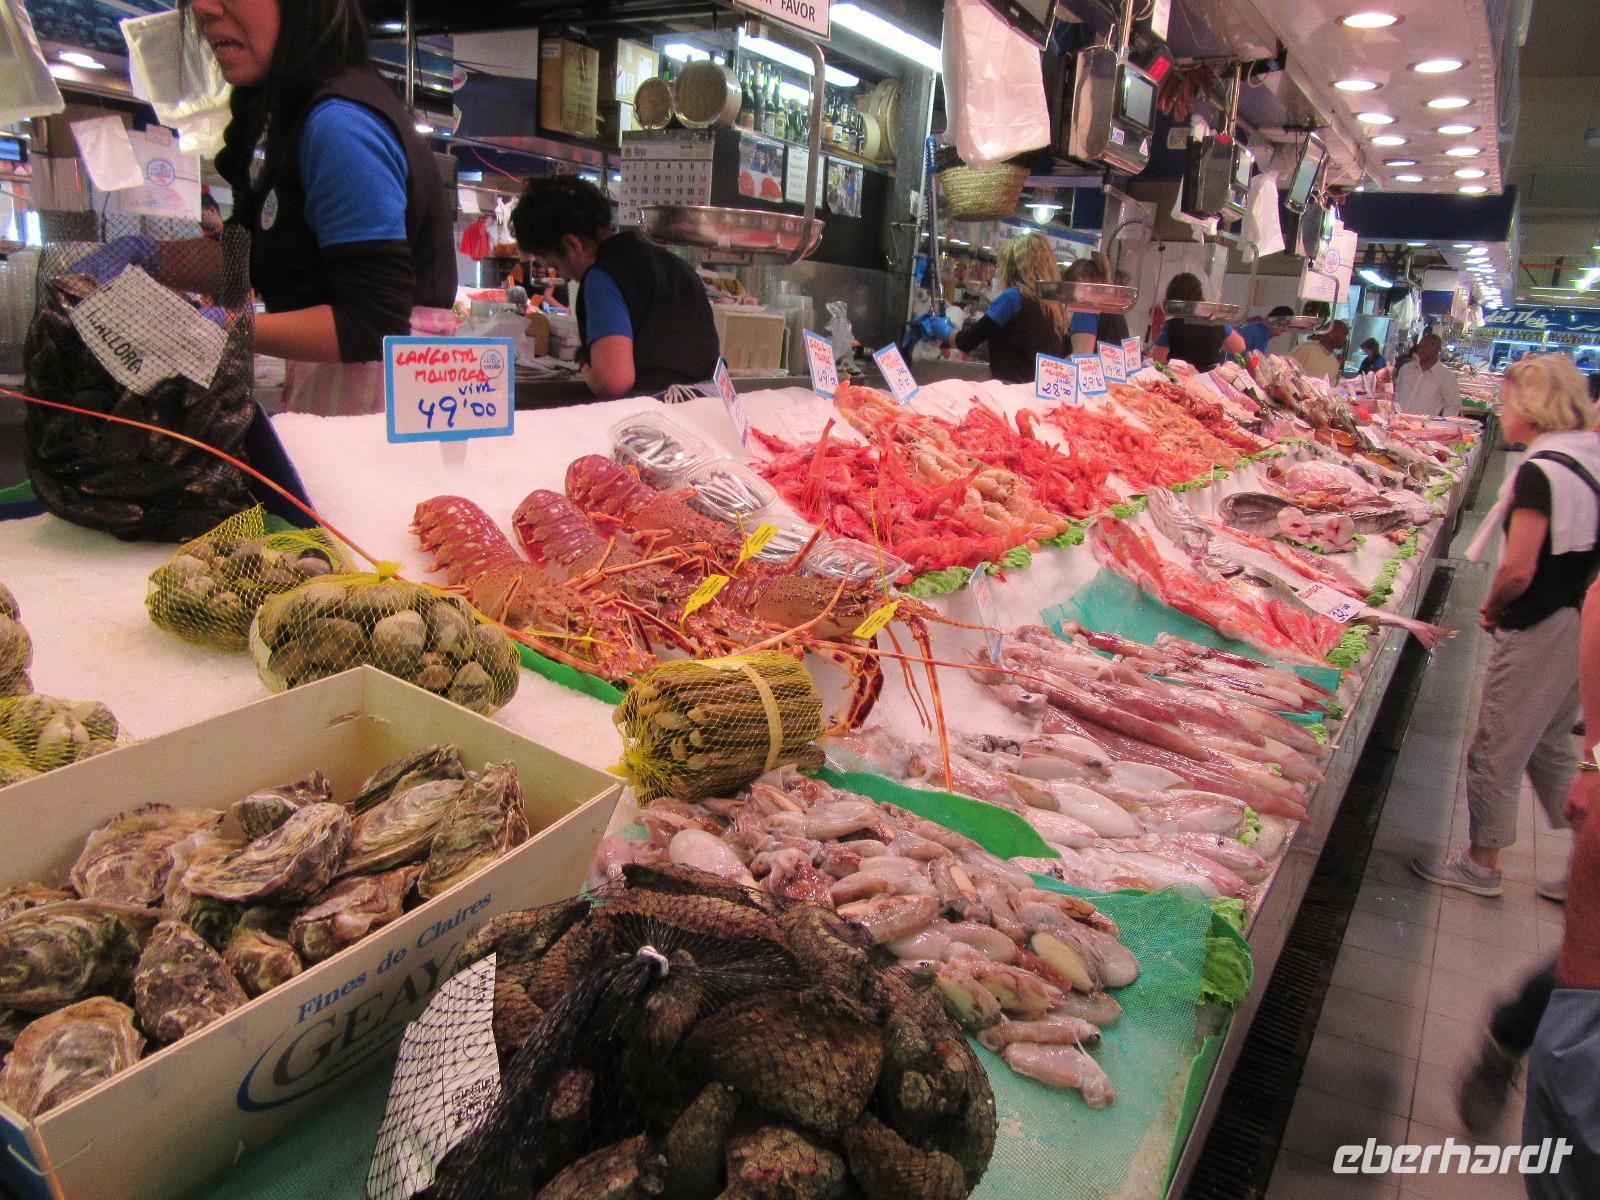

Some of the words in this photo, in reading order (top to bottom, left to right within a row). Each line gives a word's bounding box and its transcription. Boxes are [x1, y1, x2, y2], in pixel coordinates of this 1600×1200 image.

[781, 0, 816, 22] FAVOR
[418, 395, 497, 430] 49'00
[296, 969, 368, 1024] Fines
[376, 947, 408, 975] de
[416, 892, 492, 949] Claires
[272, 941, 462, 1087] GEAY
